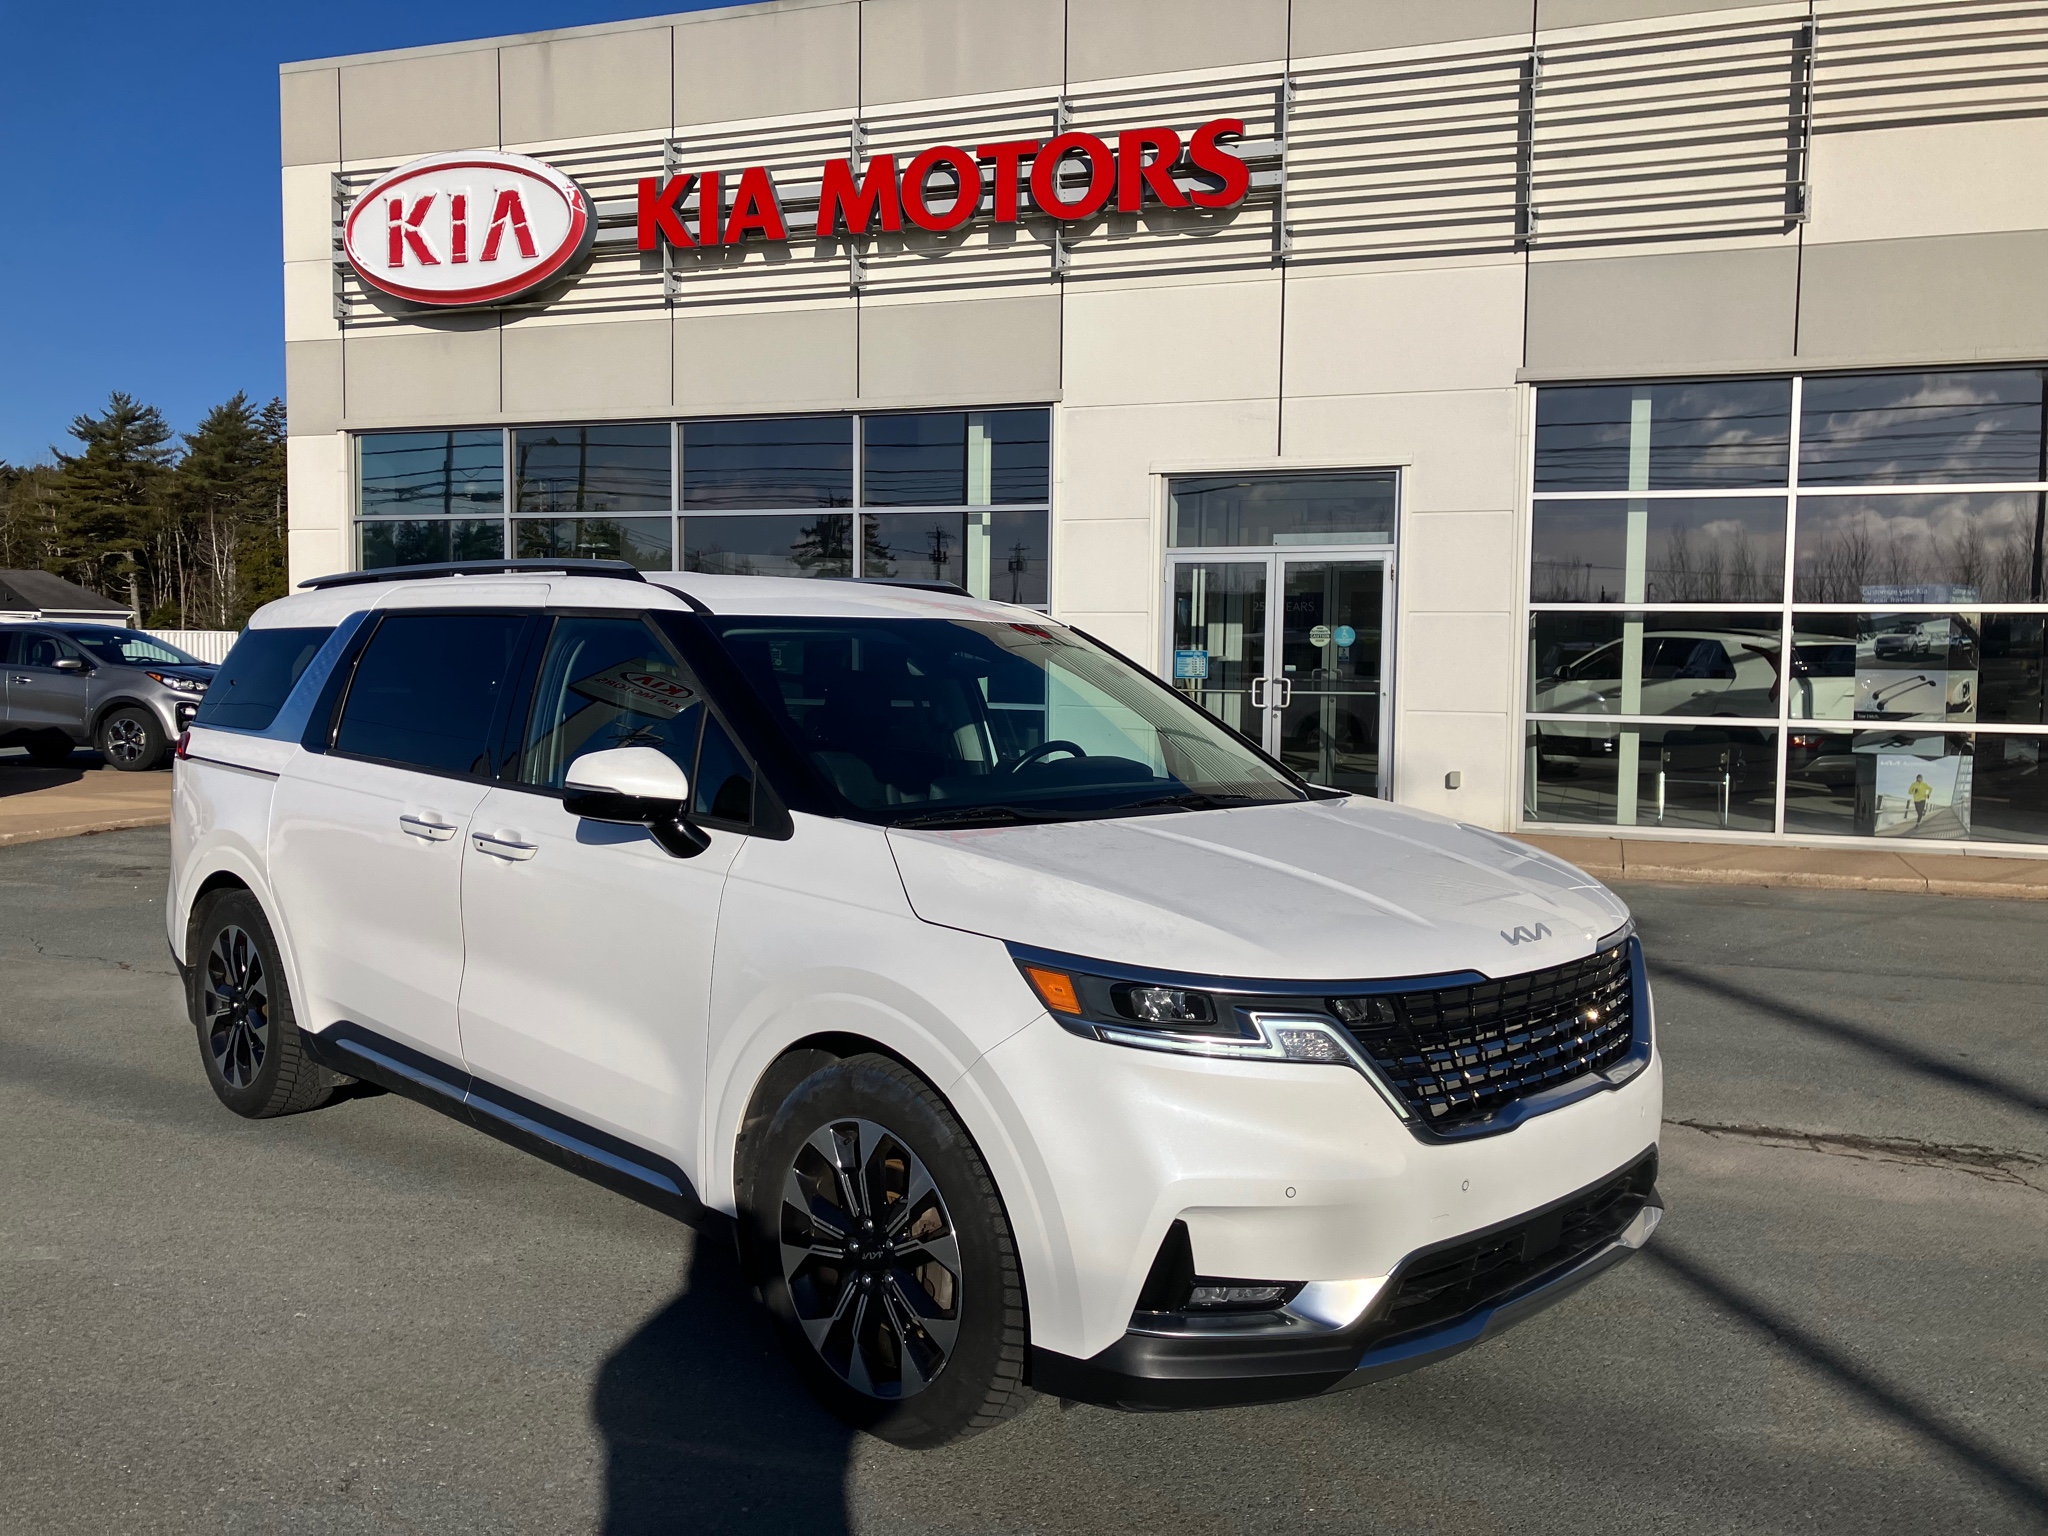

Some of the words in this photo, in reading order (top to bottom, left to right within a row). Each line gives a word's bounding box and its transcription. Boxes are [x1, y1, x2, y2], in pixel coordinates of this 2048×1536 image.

[637, 166, 789, 251] KIA
[816, 118, 1250, 237] MOTORS
[384, 184, 540, 268] KIA
[1286, 602, 1315, 612] EARS
[1500, 922, 1552, 946] KIA
